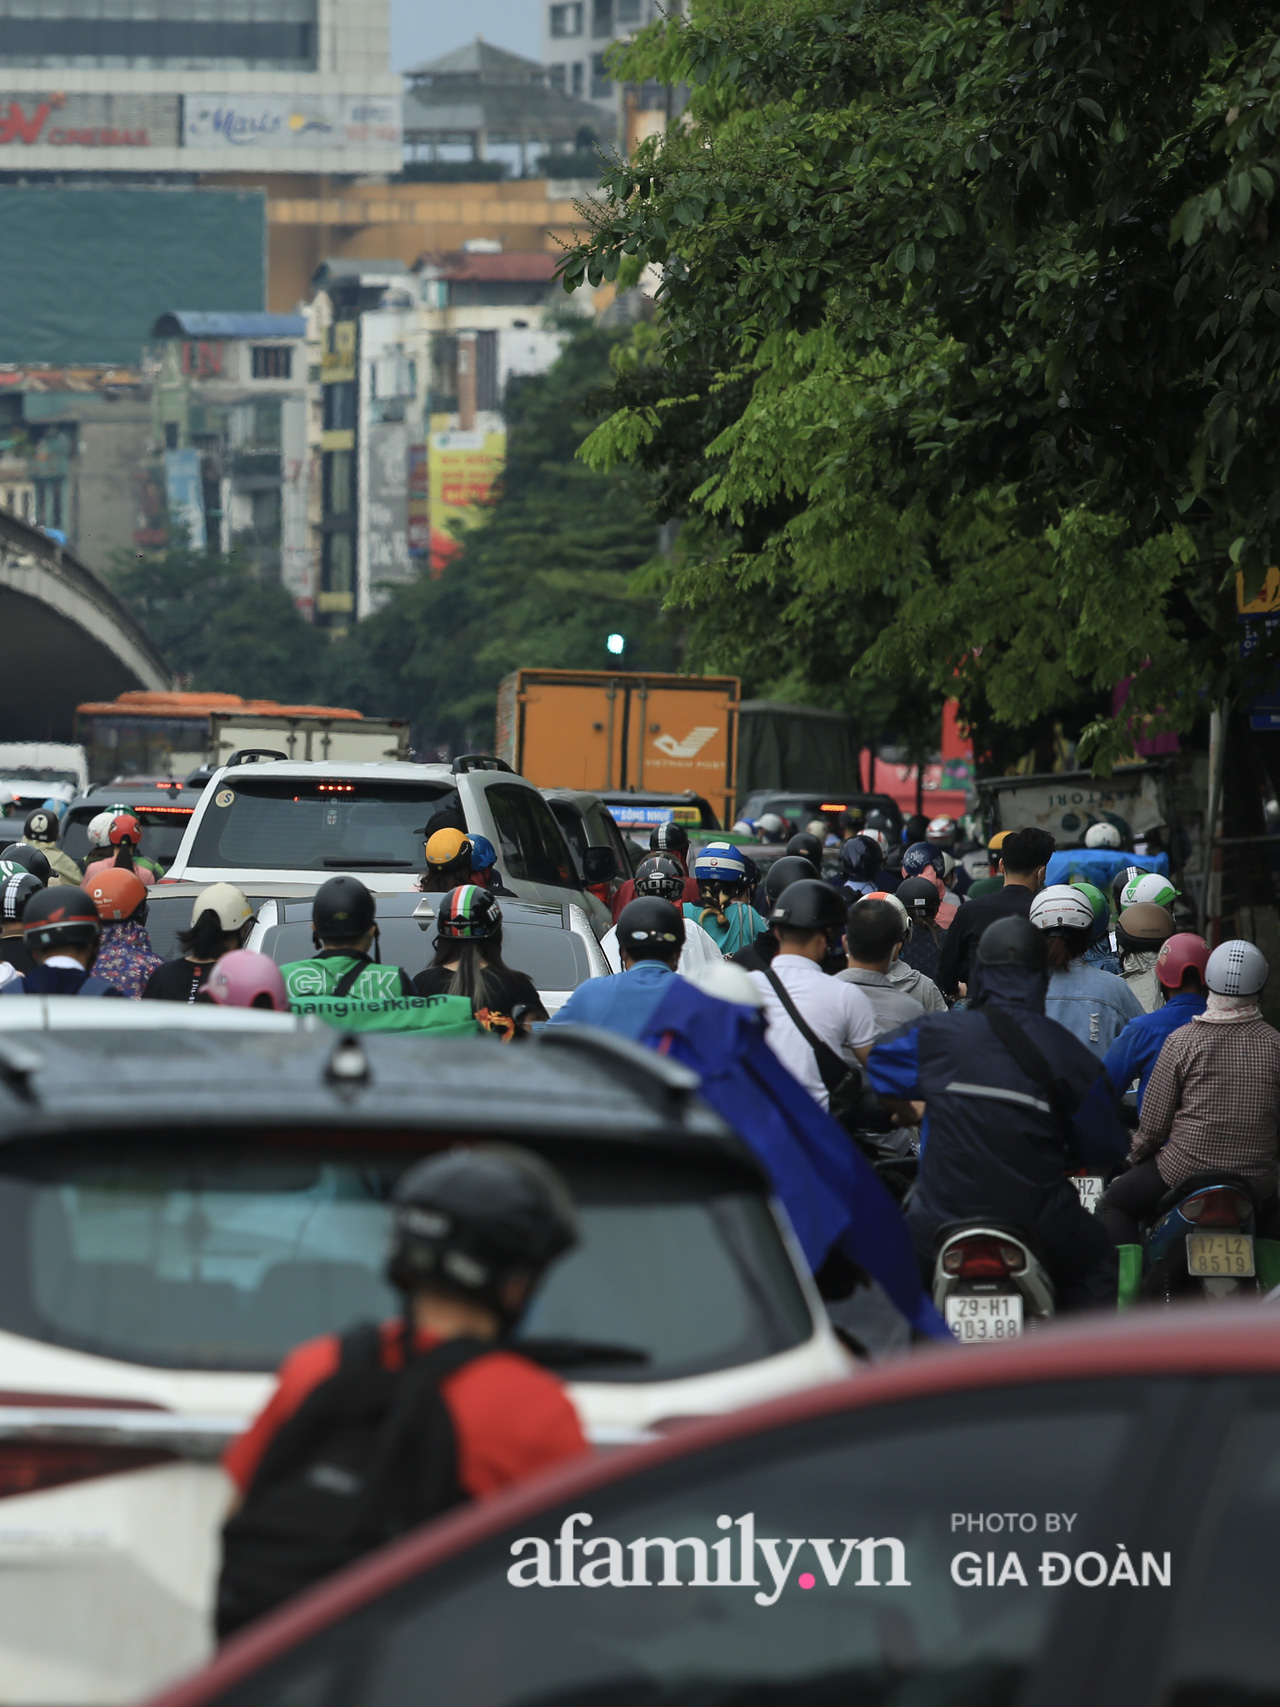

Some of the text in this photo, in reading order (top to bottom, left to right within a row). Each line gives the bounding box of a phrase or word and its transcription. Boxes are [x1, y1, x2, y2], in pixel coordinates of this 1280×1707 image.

[1199, 1238, 1244, 1255] 17-L2
[1199, 1255, 1245, 1272] 8519
[959, 1299, 1010, 1317] 29-H1
